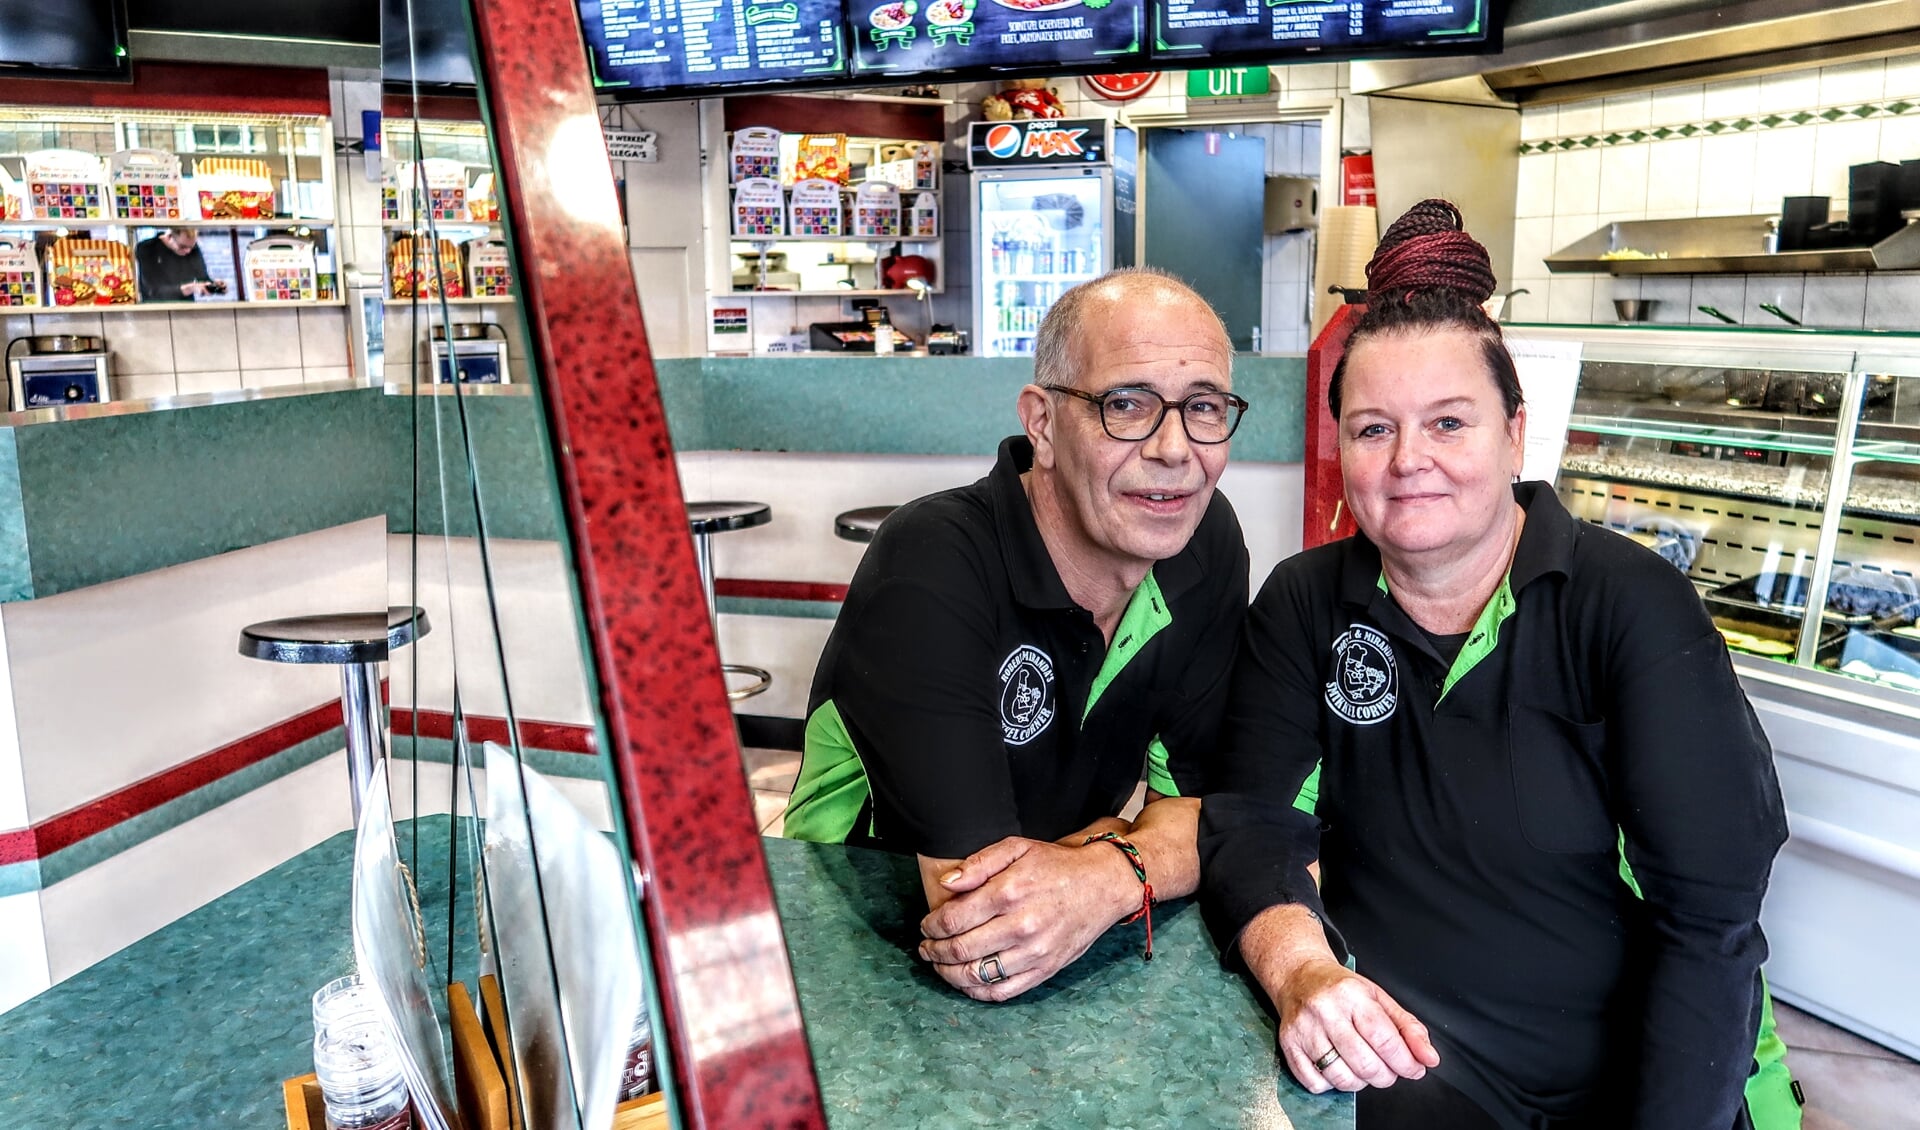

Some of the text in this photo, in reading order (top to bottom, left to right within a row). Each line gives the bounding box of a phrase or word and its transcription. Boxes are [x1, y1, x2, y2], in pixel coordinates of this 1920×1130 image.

[1008, 17, 1084, 32] SCHNITZEL GESERVEERD MET
[1054, 31, 1063, 40] EN
[1208, 67, 1248, 96] UIT
[1027, 120, 1058, 131] pepsi
[616, 135, 650, 143] WERKEN
[1021, 128, 1090, 159] MAX
[1354, 629, 1362, 638] &
[1022, 650, 1054, 683] MIRANDA'S
[1356, 692, 1395, 719] CORNER
[1019, 707, 1052, 741] CORNER
